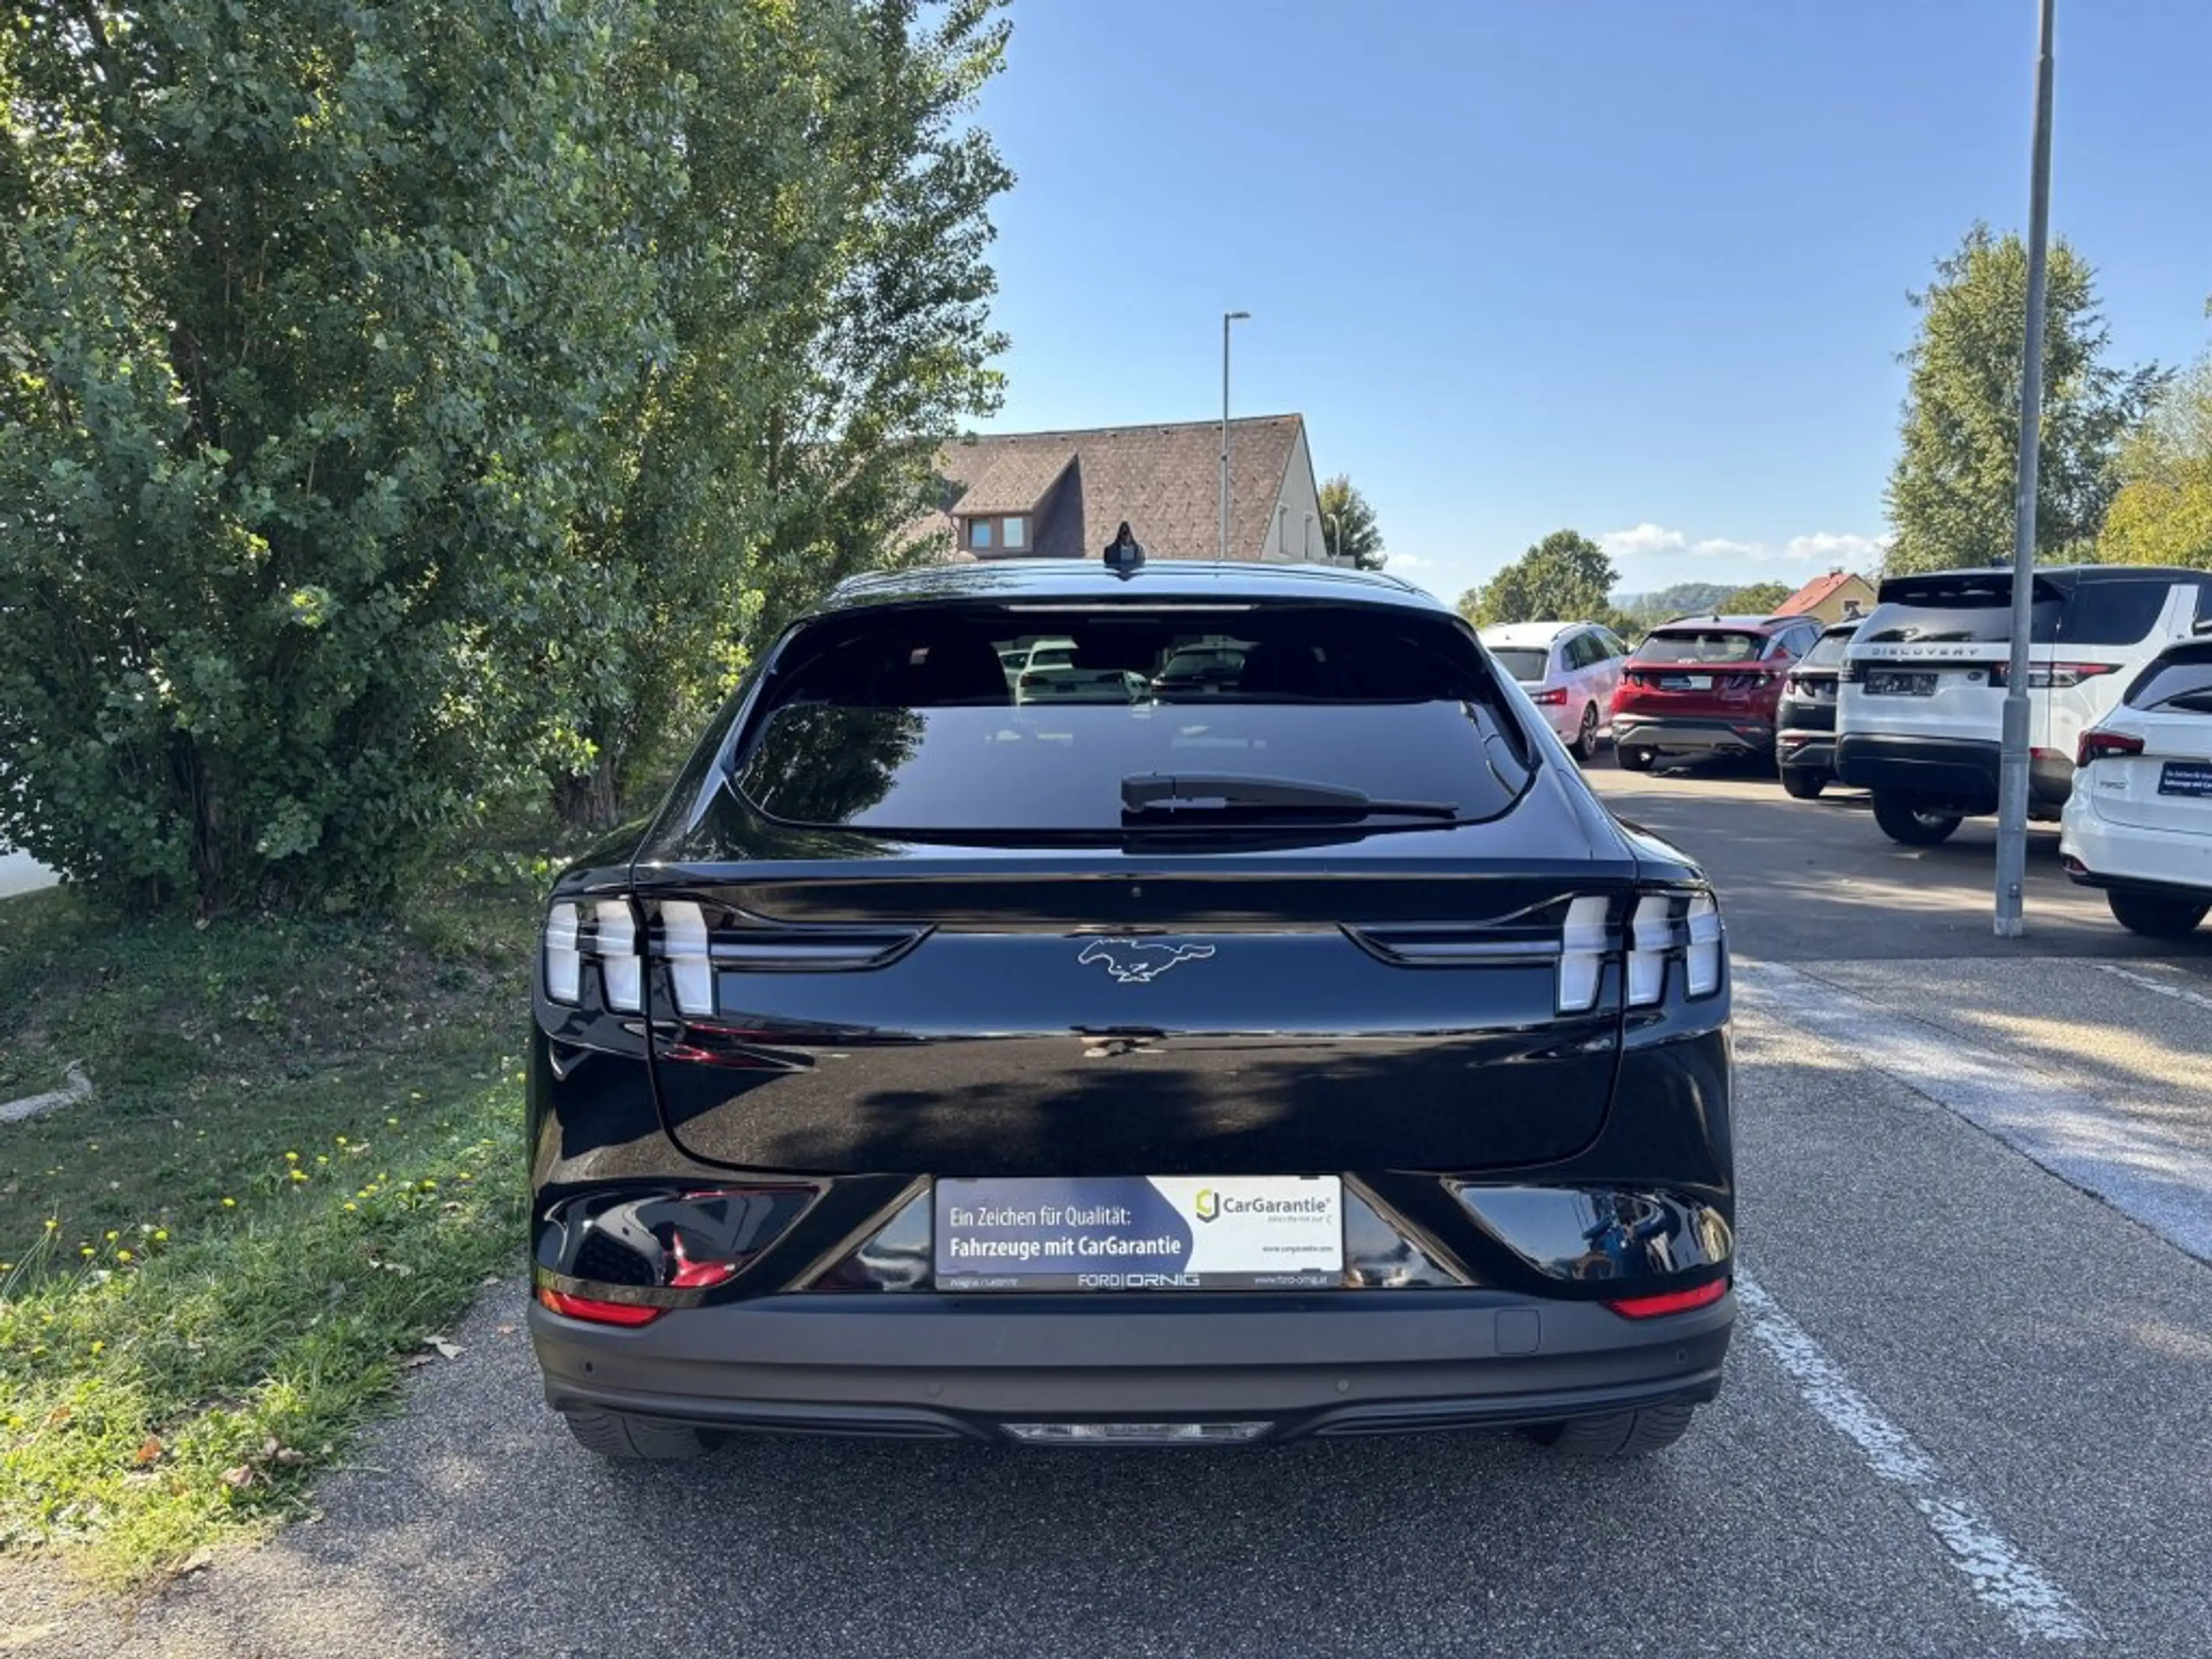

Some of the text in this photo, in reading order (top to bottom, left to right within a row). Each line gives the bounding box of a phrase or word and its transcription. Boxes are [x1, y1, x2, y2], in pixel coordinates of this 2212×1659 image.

[1872, 647, 1978, 656] DISCOVERY
[1223, 1196, 1325, 1213] CarGarantie
[950, 1205, 1131, 1228] Ein Zeichen für Qualität:
[950, 1235, 1181, 1260] Fahrzeuge mit CarGarantie
[1078, 1274, 1200, 1287] FORD ORNIG
